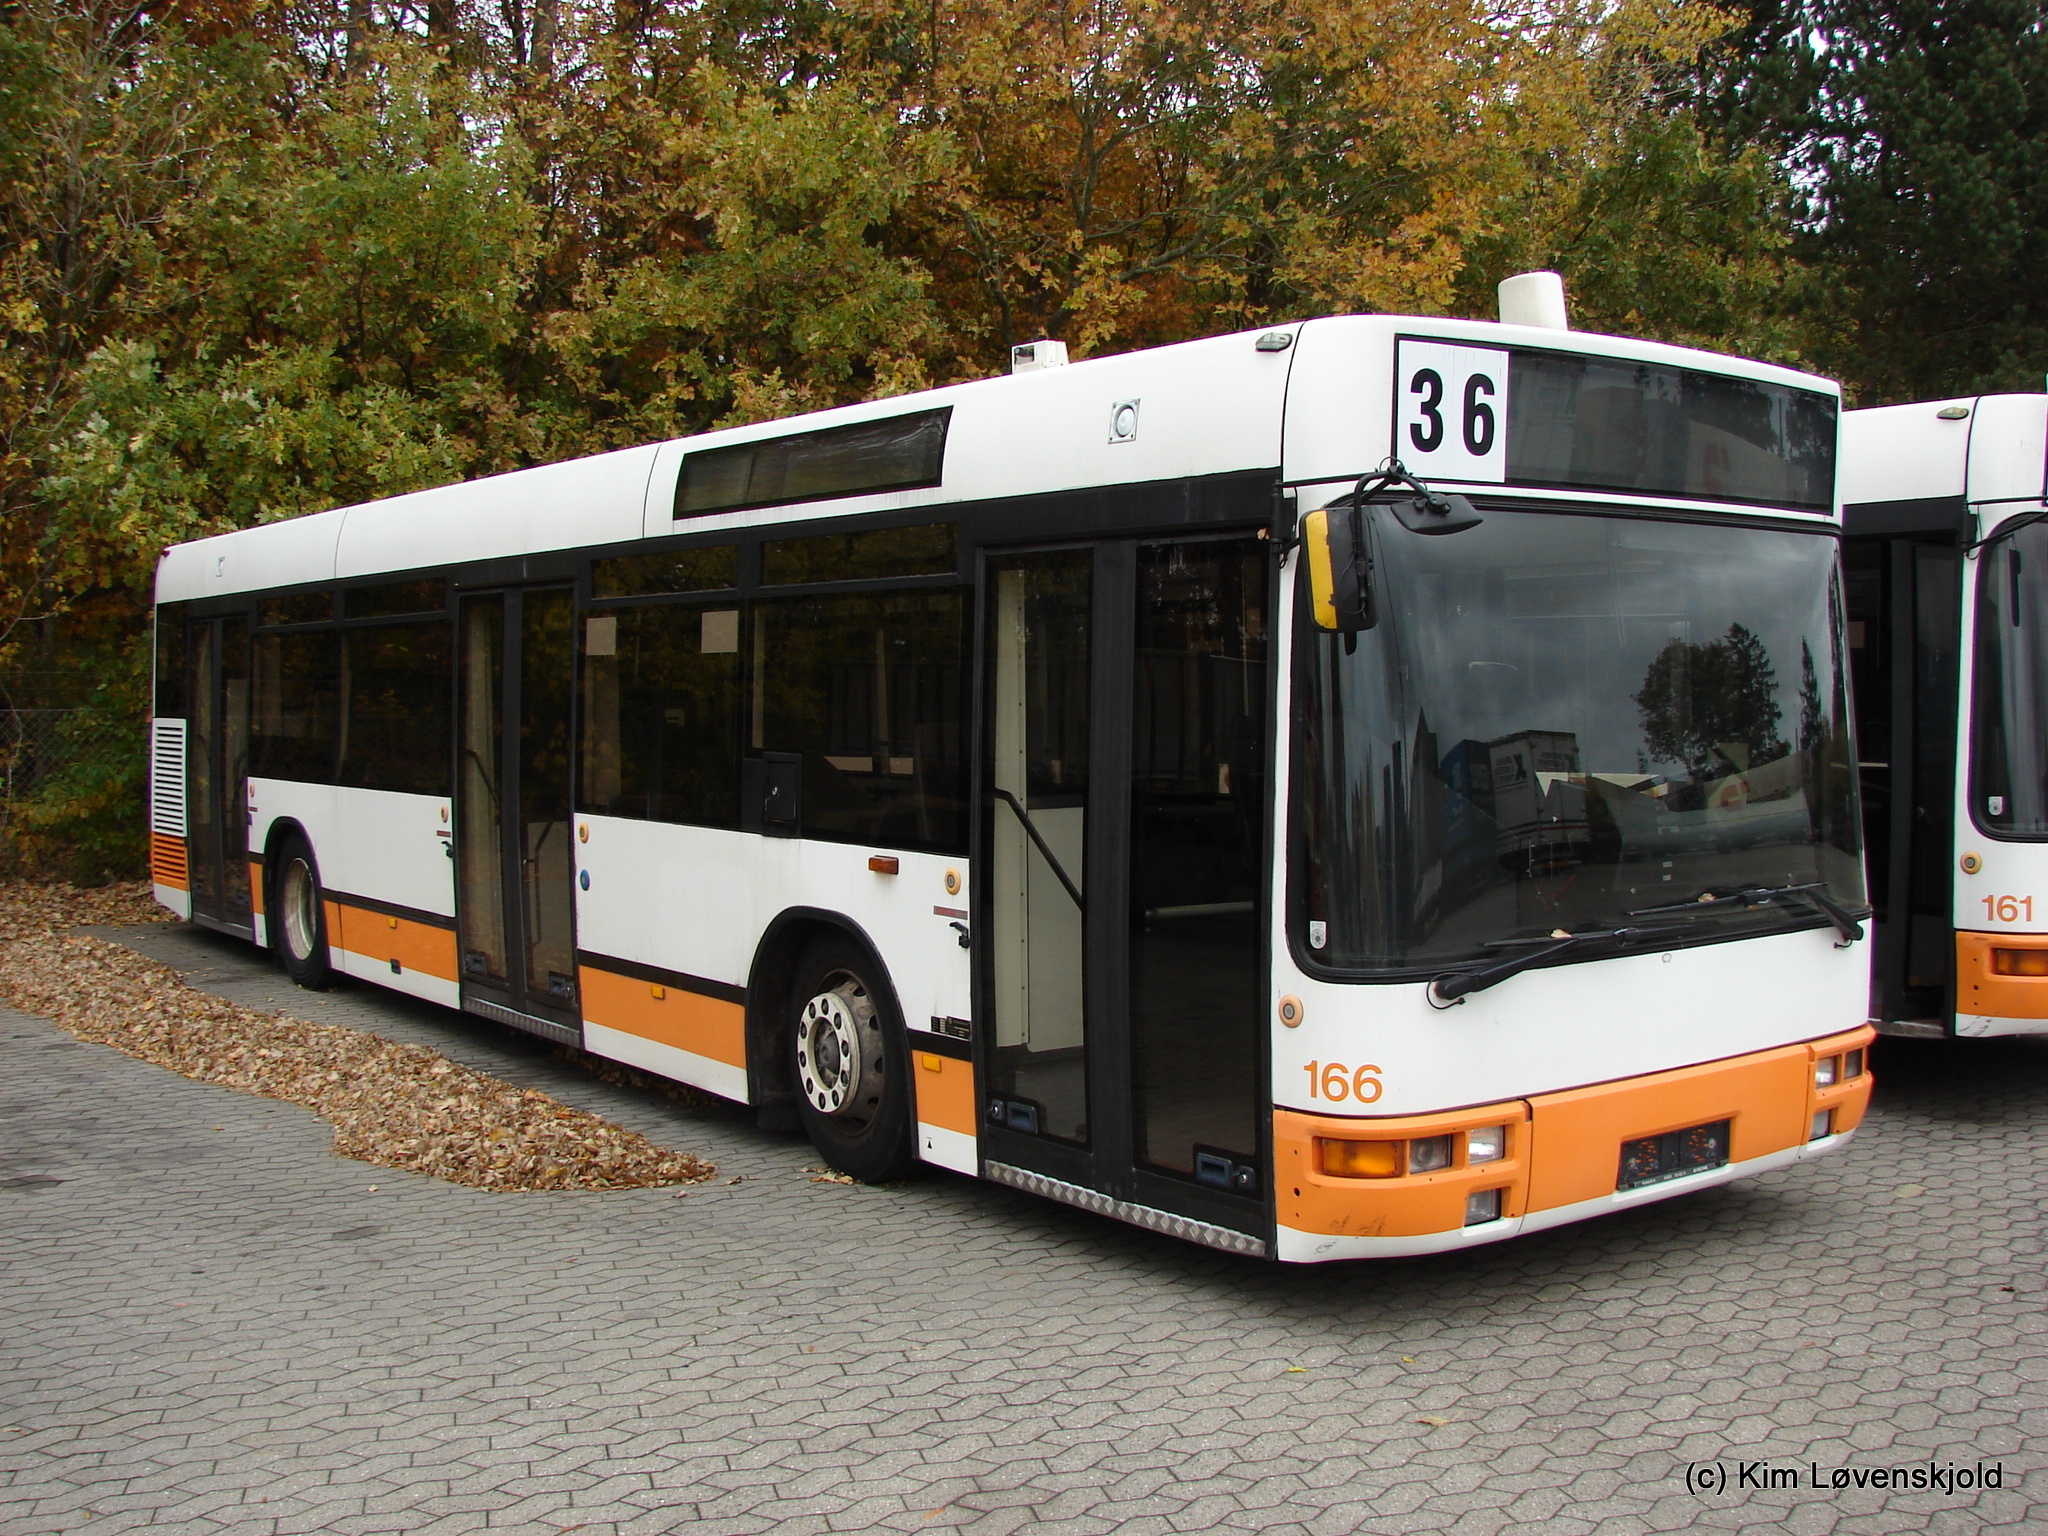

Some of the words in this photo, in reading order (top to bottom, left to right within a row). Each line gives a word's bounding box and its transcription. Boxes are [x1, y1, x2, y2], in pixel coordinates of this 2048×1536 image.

[1409, 368, 1495, 457] 36
[1981, 894, 2033, 923] 161
[1303, 1060, 1384, 1104] 166
